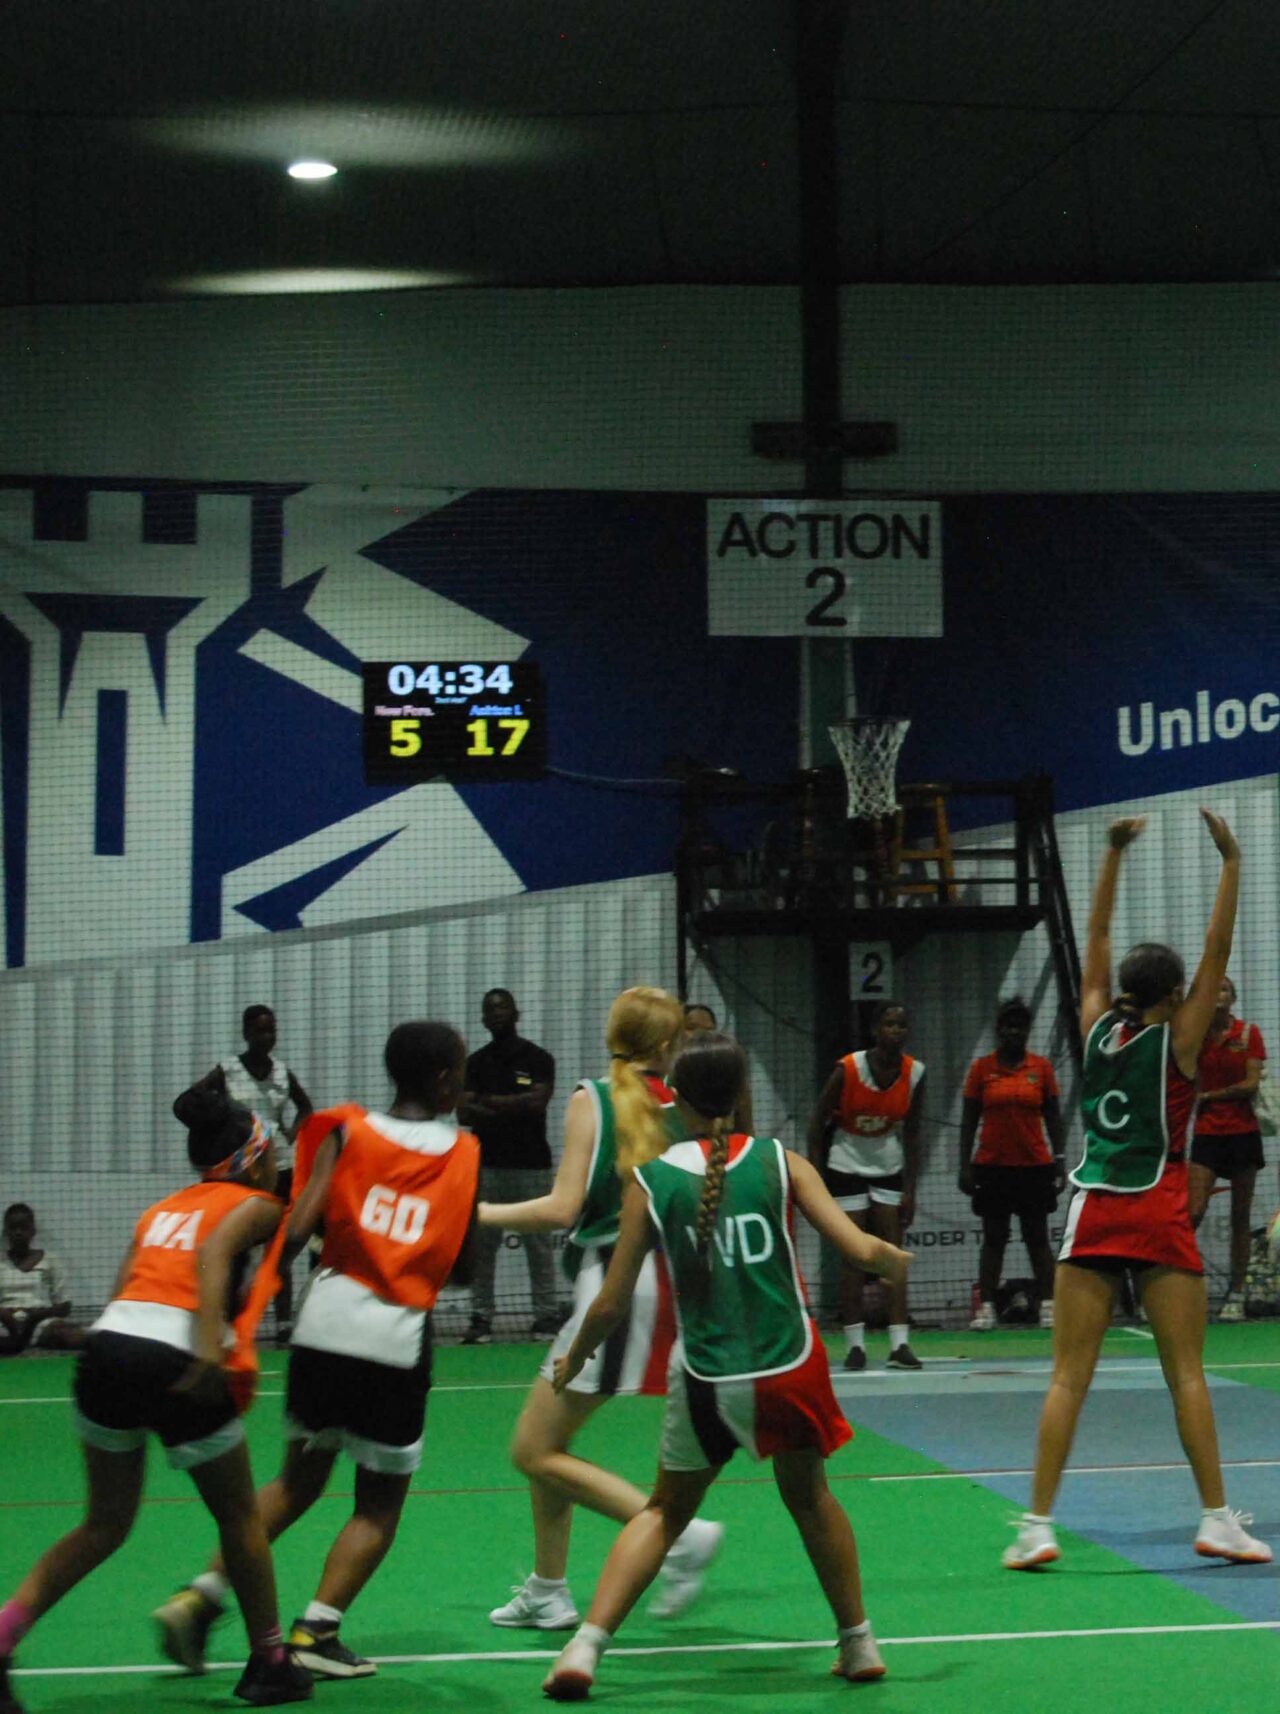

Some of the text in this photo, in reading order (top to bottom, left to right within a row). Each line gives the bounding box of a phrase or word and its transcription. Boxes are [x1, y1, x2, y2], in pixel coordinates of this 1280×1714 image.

[716, 512, 930, 559] ACTION
[805, 566, 848, 626] 2
[387, 664, 513, 695] 04:34
[389, 718, 531, 757] 5 17
[862, 951, 883, 993] 2
[1098, 1089, 1131, 1130] C
[141, 1210, 205, 1251] WA
[358, 1183, 431, 1246] GD
[905, 1230, 965, 1247] NDER
